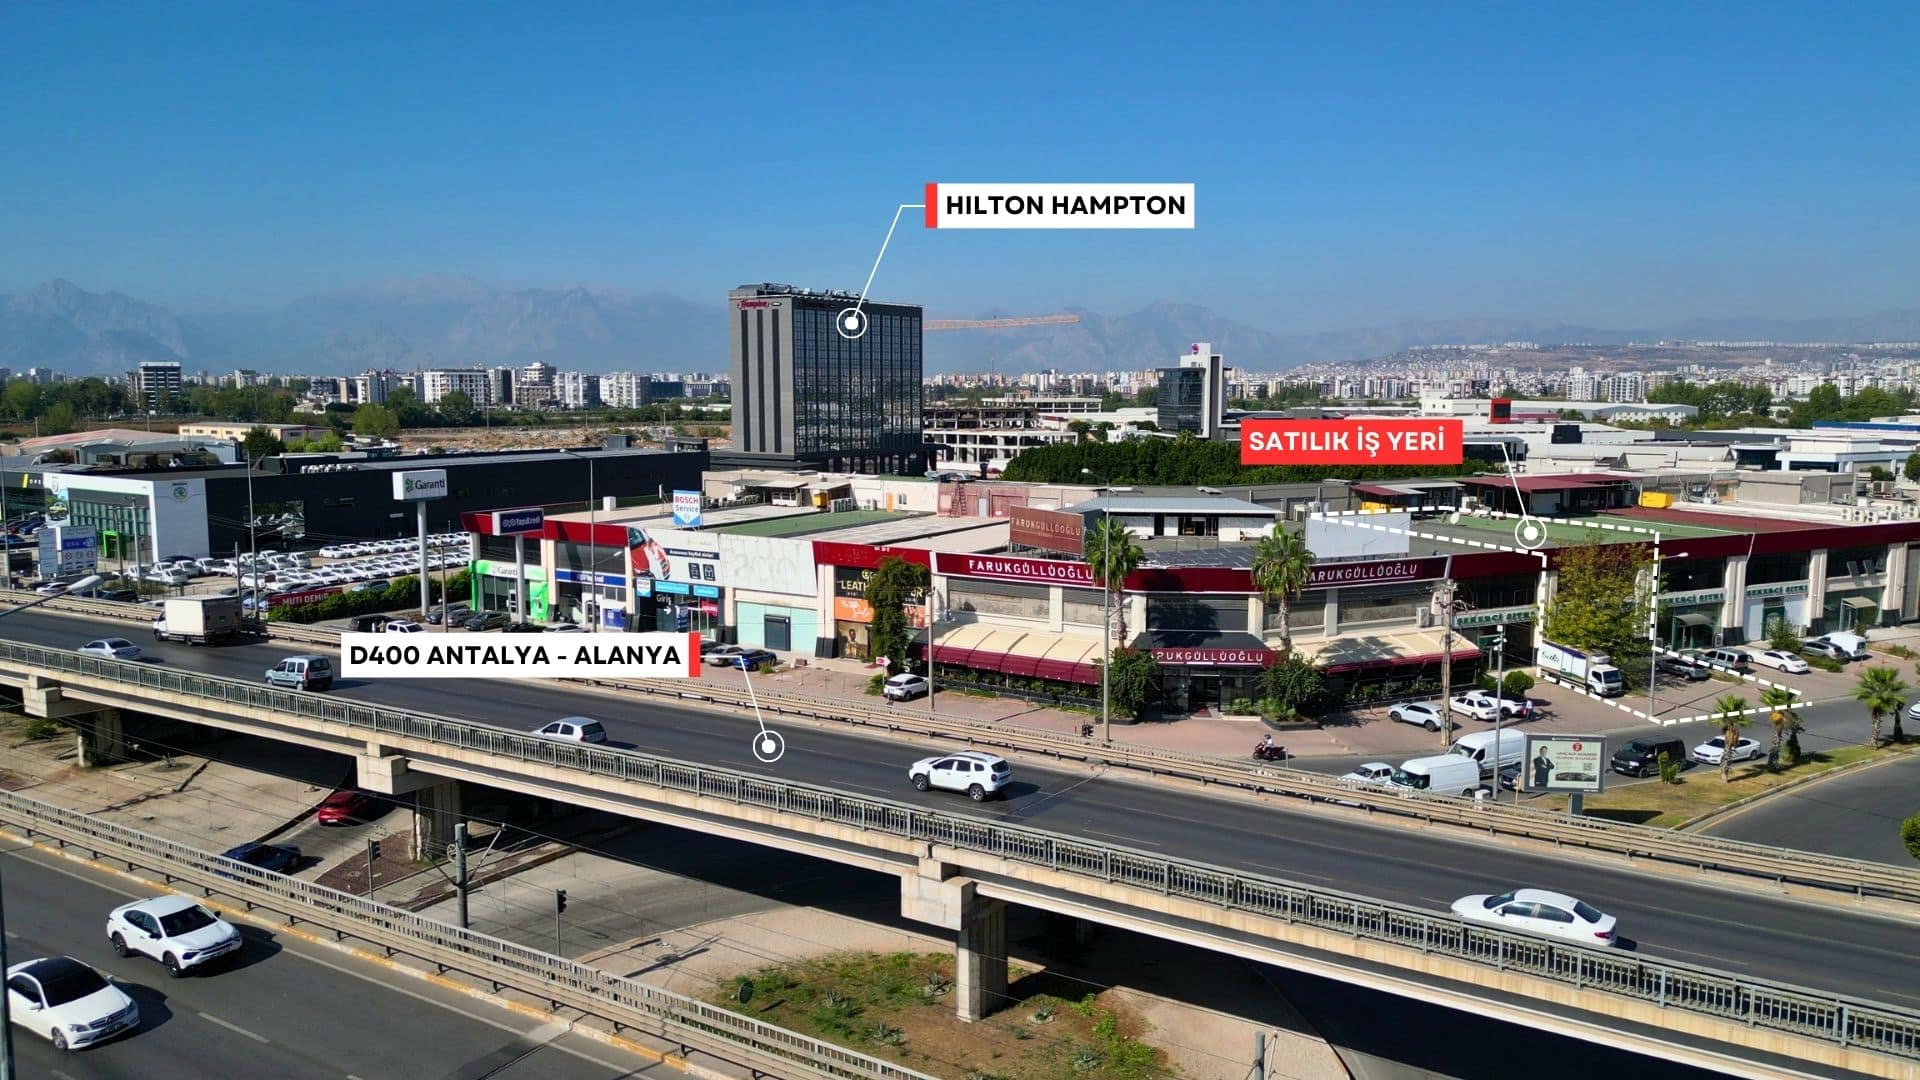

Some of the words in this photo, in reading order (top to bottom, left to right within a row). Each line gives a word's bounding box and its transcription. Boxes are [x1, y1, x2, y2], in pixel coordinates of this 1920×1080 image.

[415, 480, 445, 489] Garanti
[674, 496, 699, 504] BOSCH
[1306, 562, 1417, 582] ARUKGÜLLÜOĞLU
[1151, 651, 1263, 662] RUKGÜLLÜOĞLU
